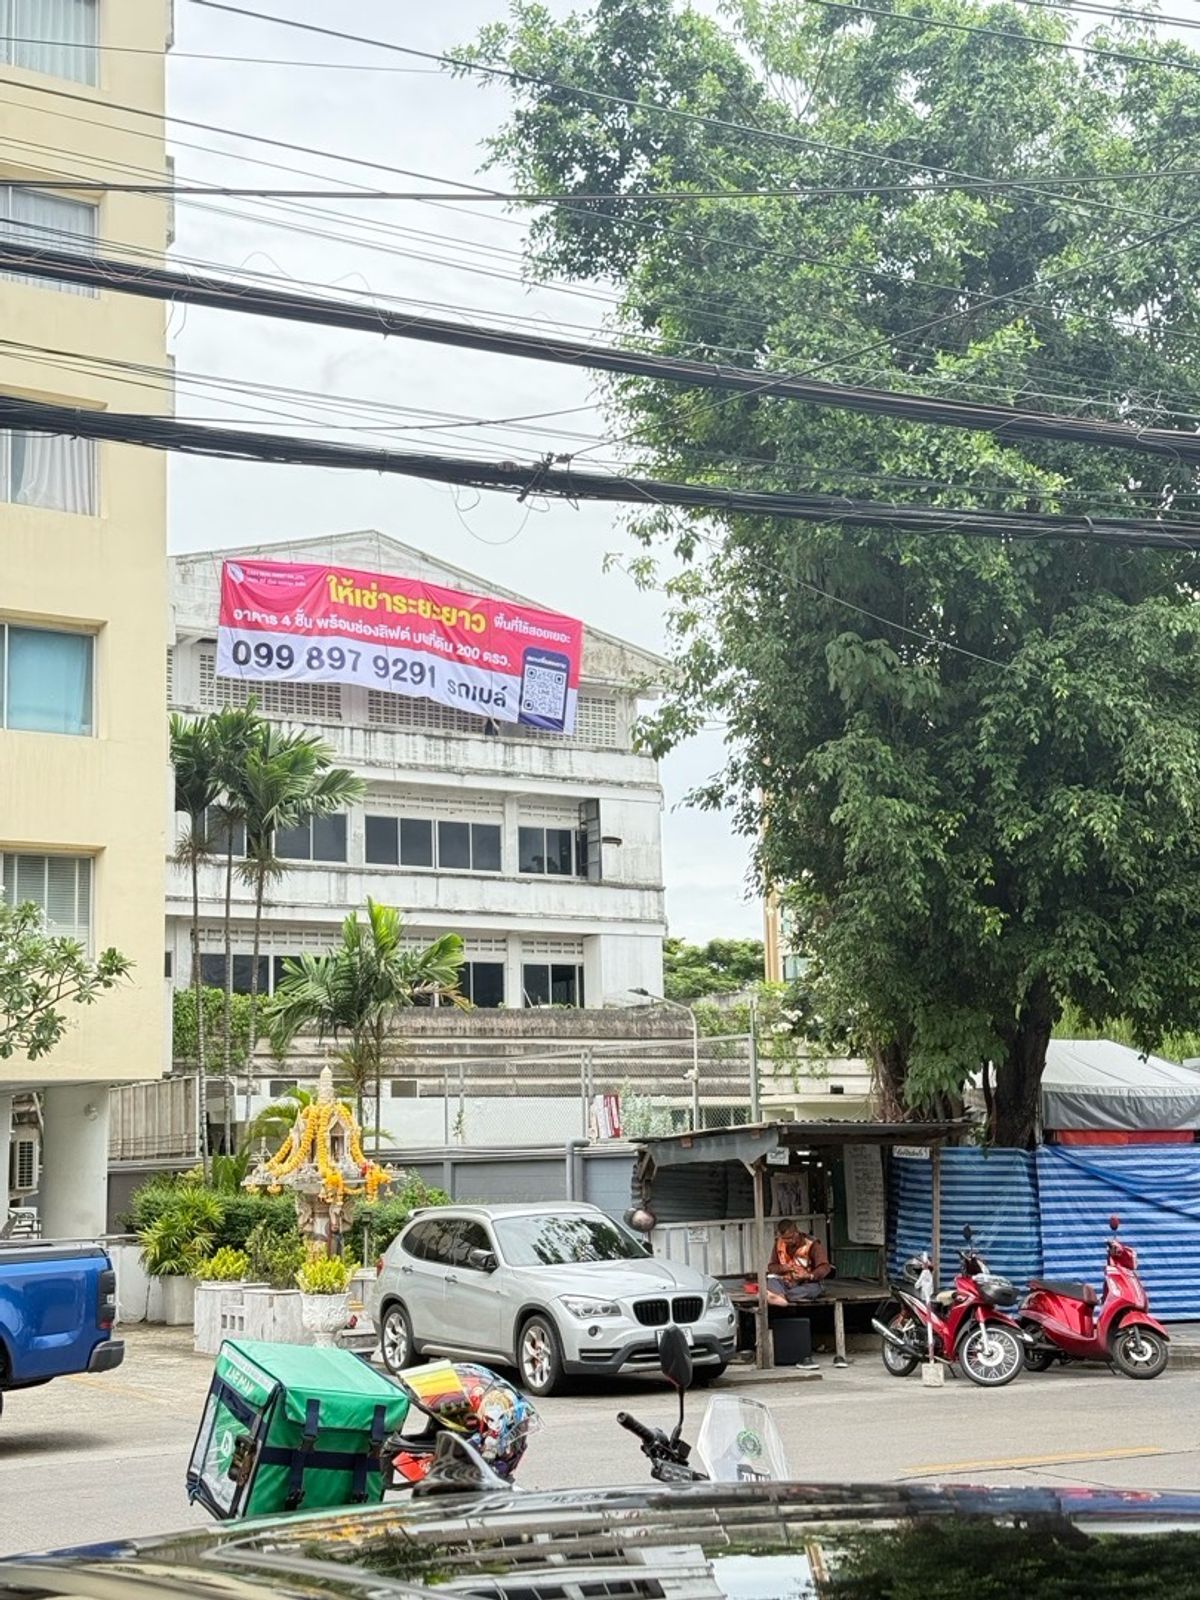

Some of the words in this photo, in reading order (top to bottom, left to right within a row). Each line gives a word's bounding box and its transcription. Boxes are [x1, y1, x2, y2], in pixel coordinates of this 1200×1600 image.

[233, 608, 278, 626] อาคาร
[281, 615, 292, 626] 4
[295, 609, 313, 629] ชั้น
[456, 644, 480, 660] 200
[326, 575, 487, 634] ให้เช่าระยะยาว
[232, 640, 295, 671] 099
[306, 646, 362, 672] 897
[372, 655, 436, 689] 9291
[447, 678, 508, 708] รถเมล์
